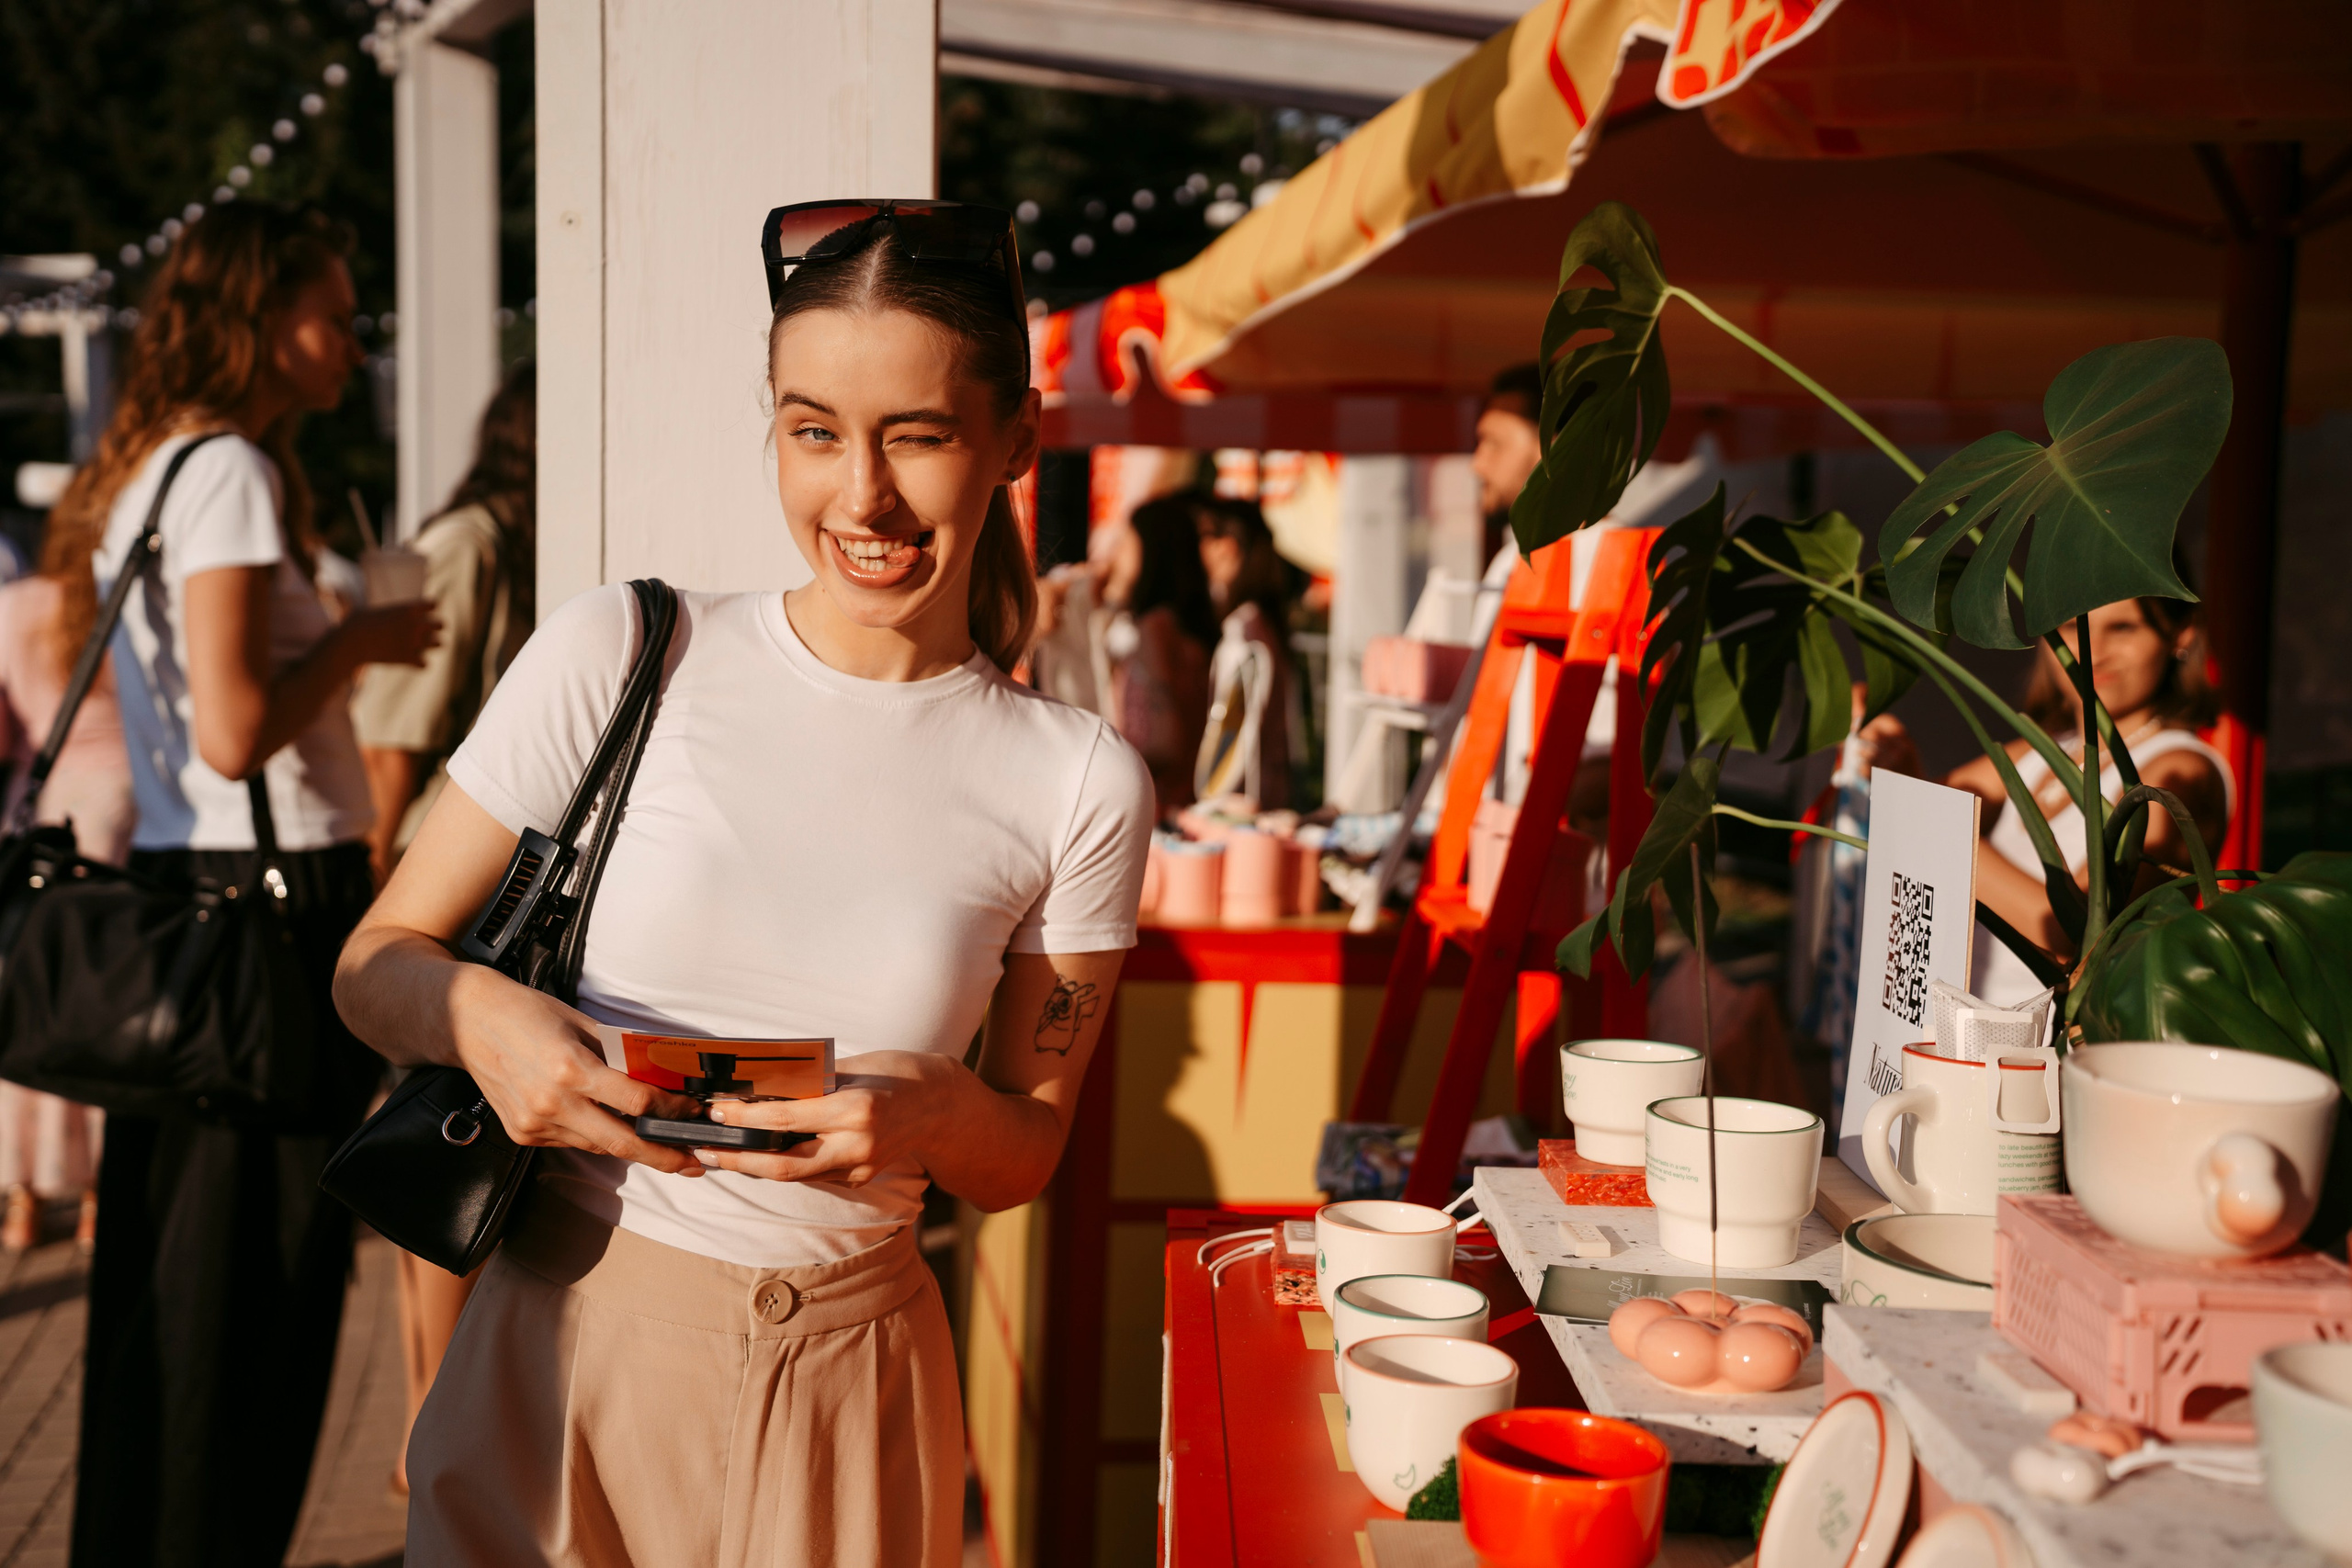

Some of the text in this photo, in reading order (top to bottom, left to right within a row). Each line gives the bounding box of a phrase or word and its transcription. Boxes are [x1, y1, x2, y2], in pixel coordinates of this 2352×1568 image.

[1679, 1164, 1691, 1172] very
[2038, 1160, 2052, 1168] good
[1663, 1168, 1672, 1177] and
[1672, 1172, 1685, 1180] early
[1685, 1174, 1699, 1183] long
